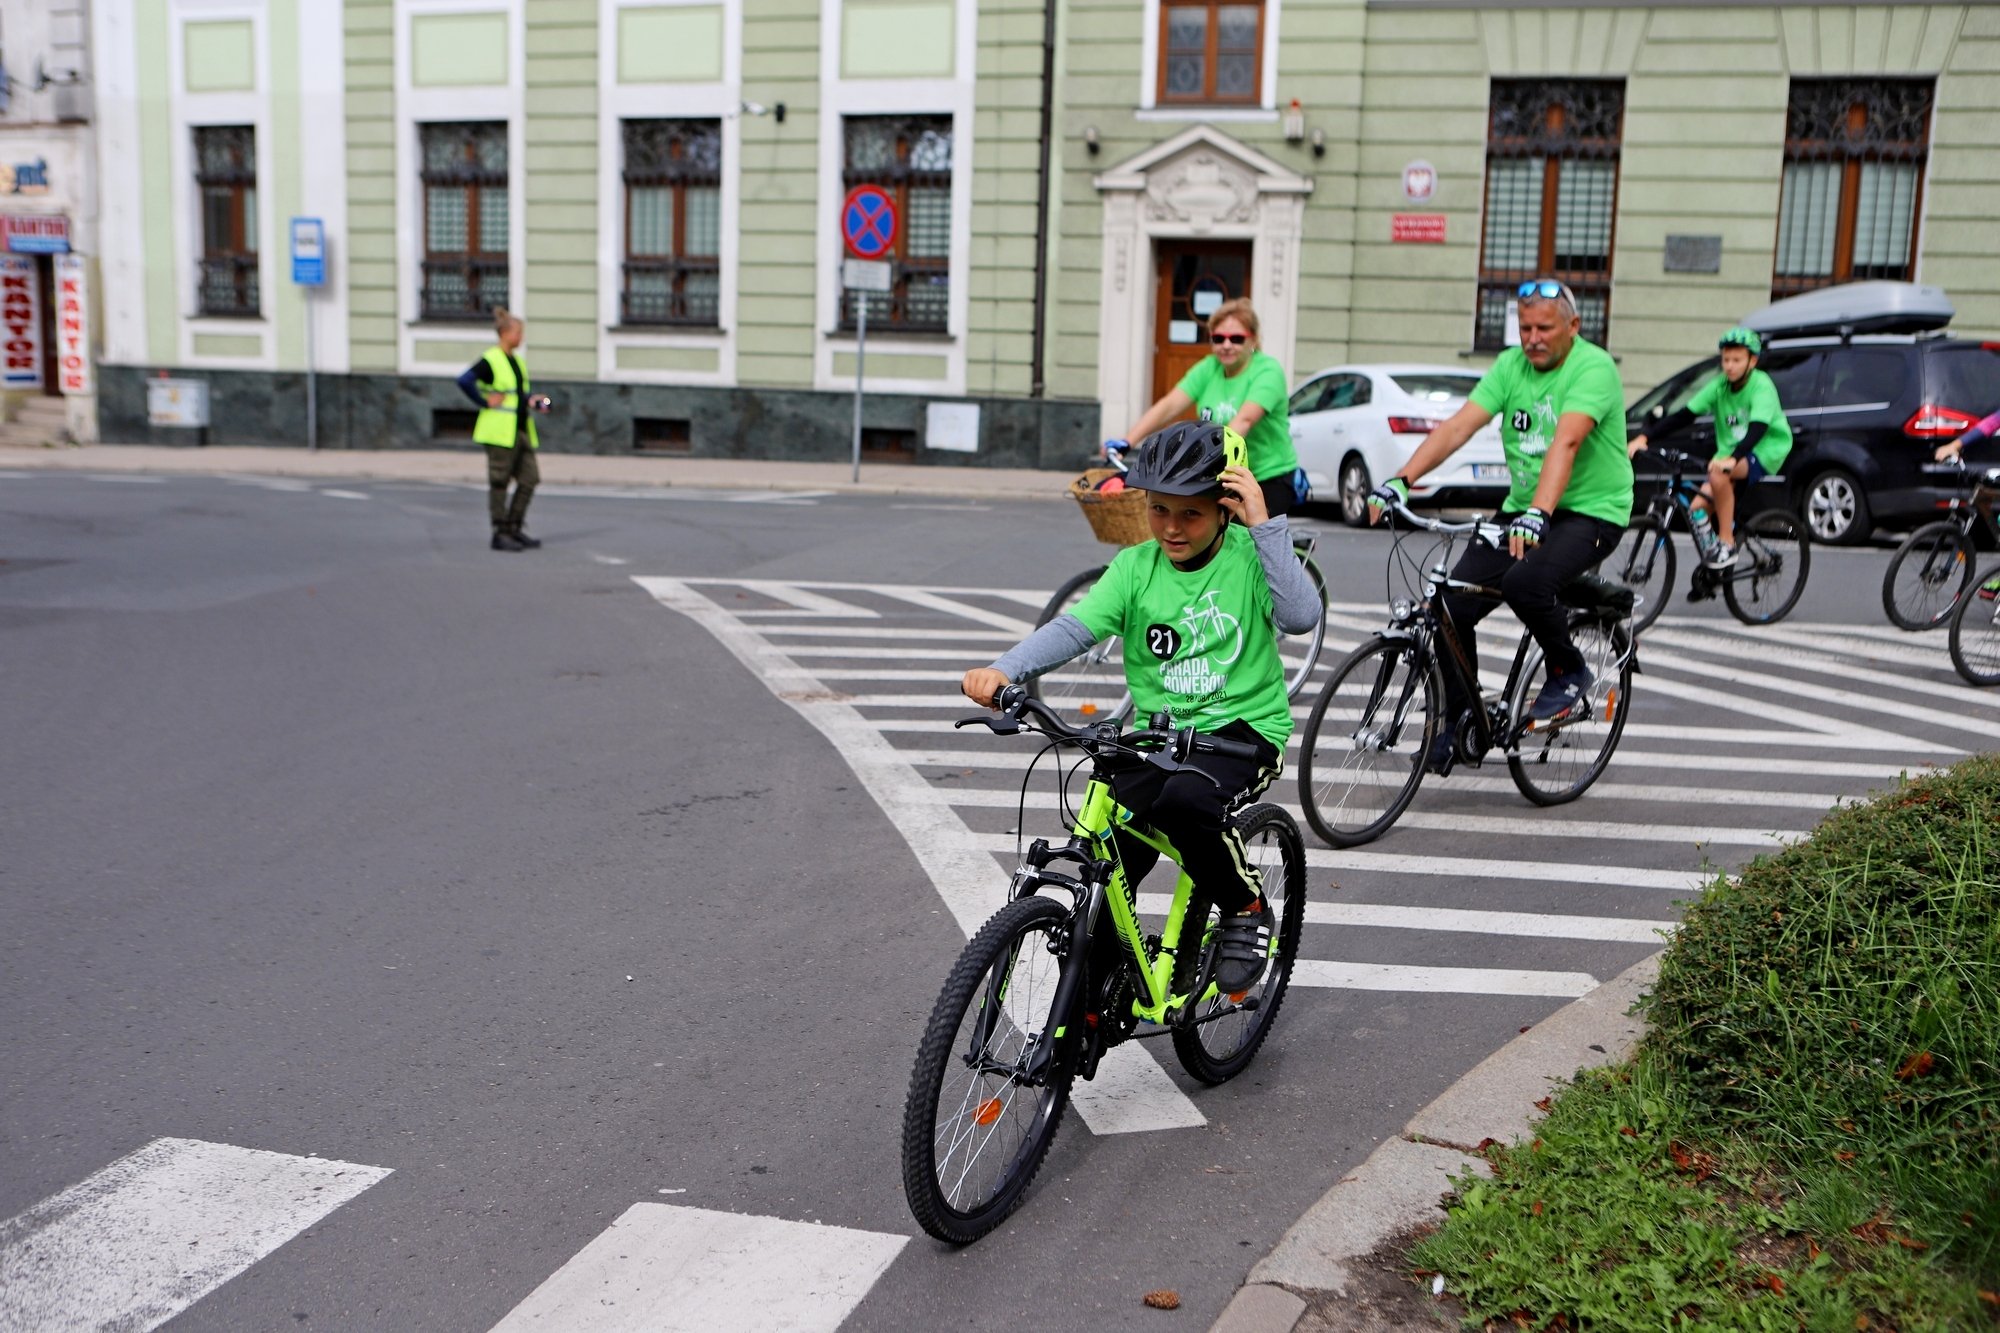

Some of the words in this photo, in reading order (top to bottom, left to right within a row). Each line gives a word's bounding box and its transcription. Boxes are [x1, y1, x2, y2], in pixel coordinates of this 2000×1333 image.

[3, 276, 34, 369] KANTOR
[63, 280, 82, 387] KANTOR
[1513, 410, 1528, 430] 21
[1150, 628, 1174, 655] 21
[1159, 657, 1210, 676] PARADA
[1163, 672, 1228, 694] ROWERÓW
